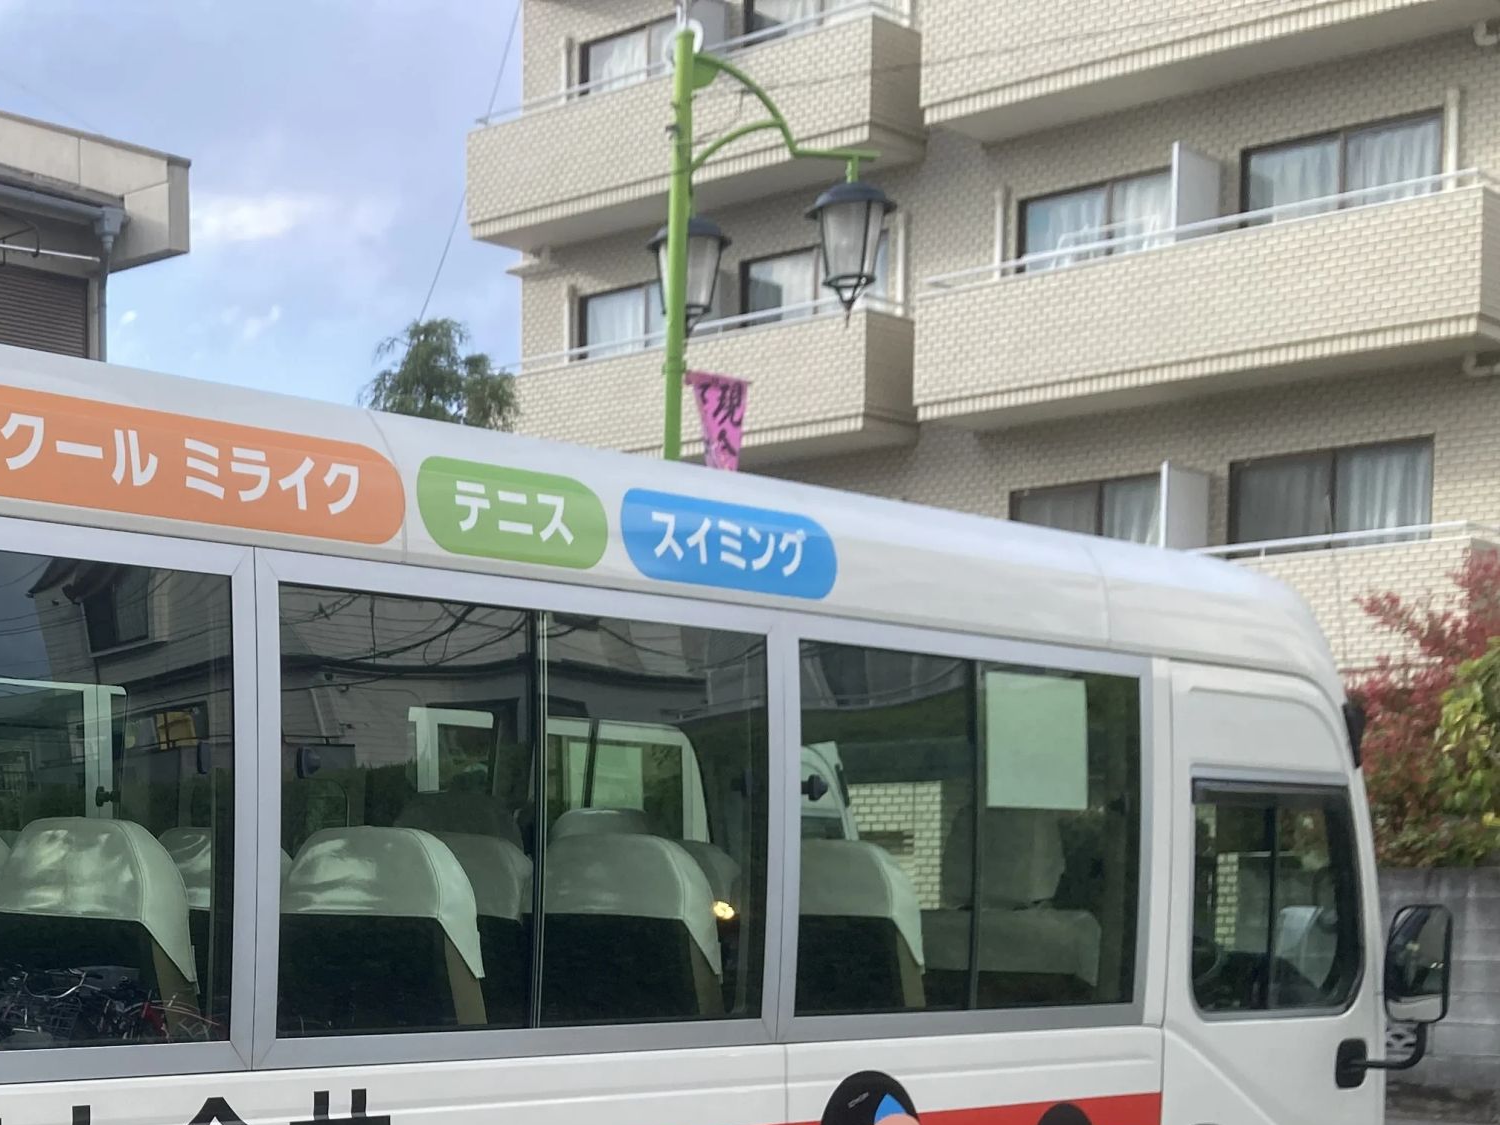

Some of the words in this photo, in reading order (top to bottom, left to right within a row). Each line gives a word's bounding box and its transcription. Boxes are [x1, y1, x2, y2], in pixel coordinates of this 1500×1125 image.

[183, 437, 361, 516] ミライク
[454, 479, 575, 546] テニス
[650, 510, 807, 578] スイミング
